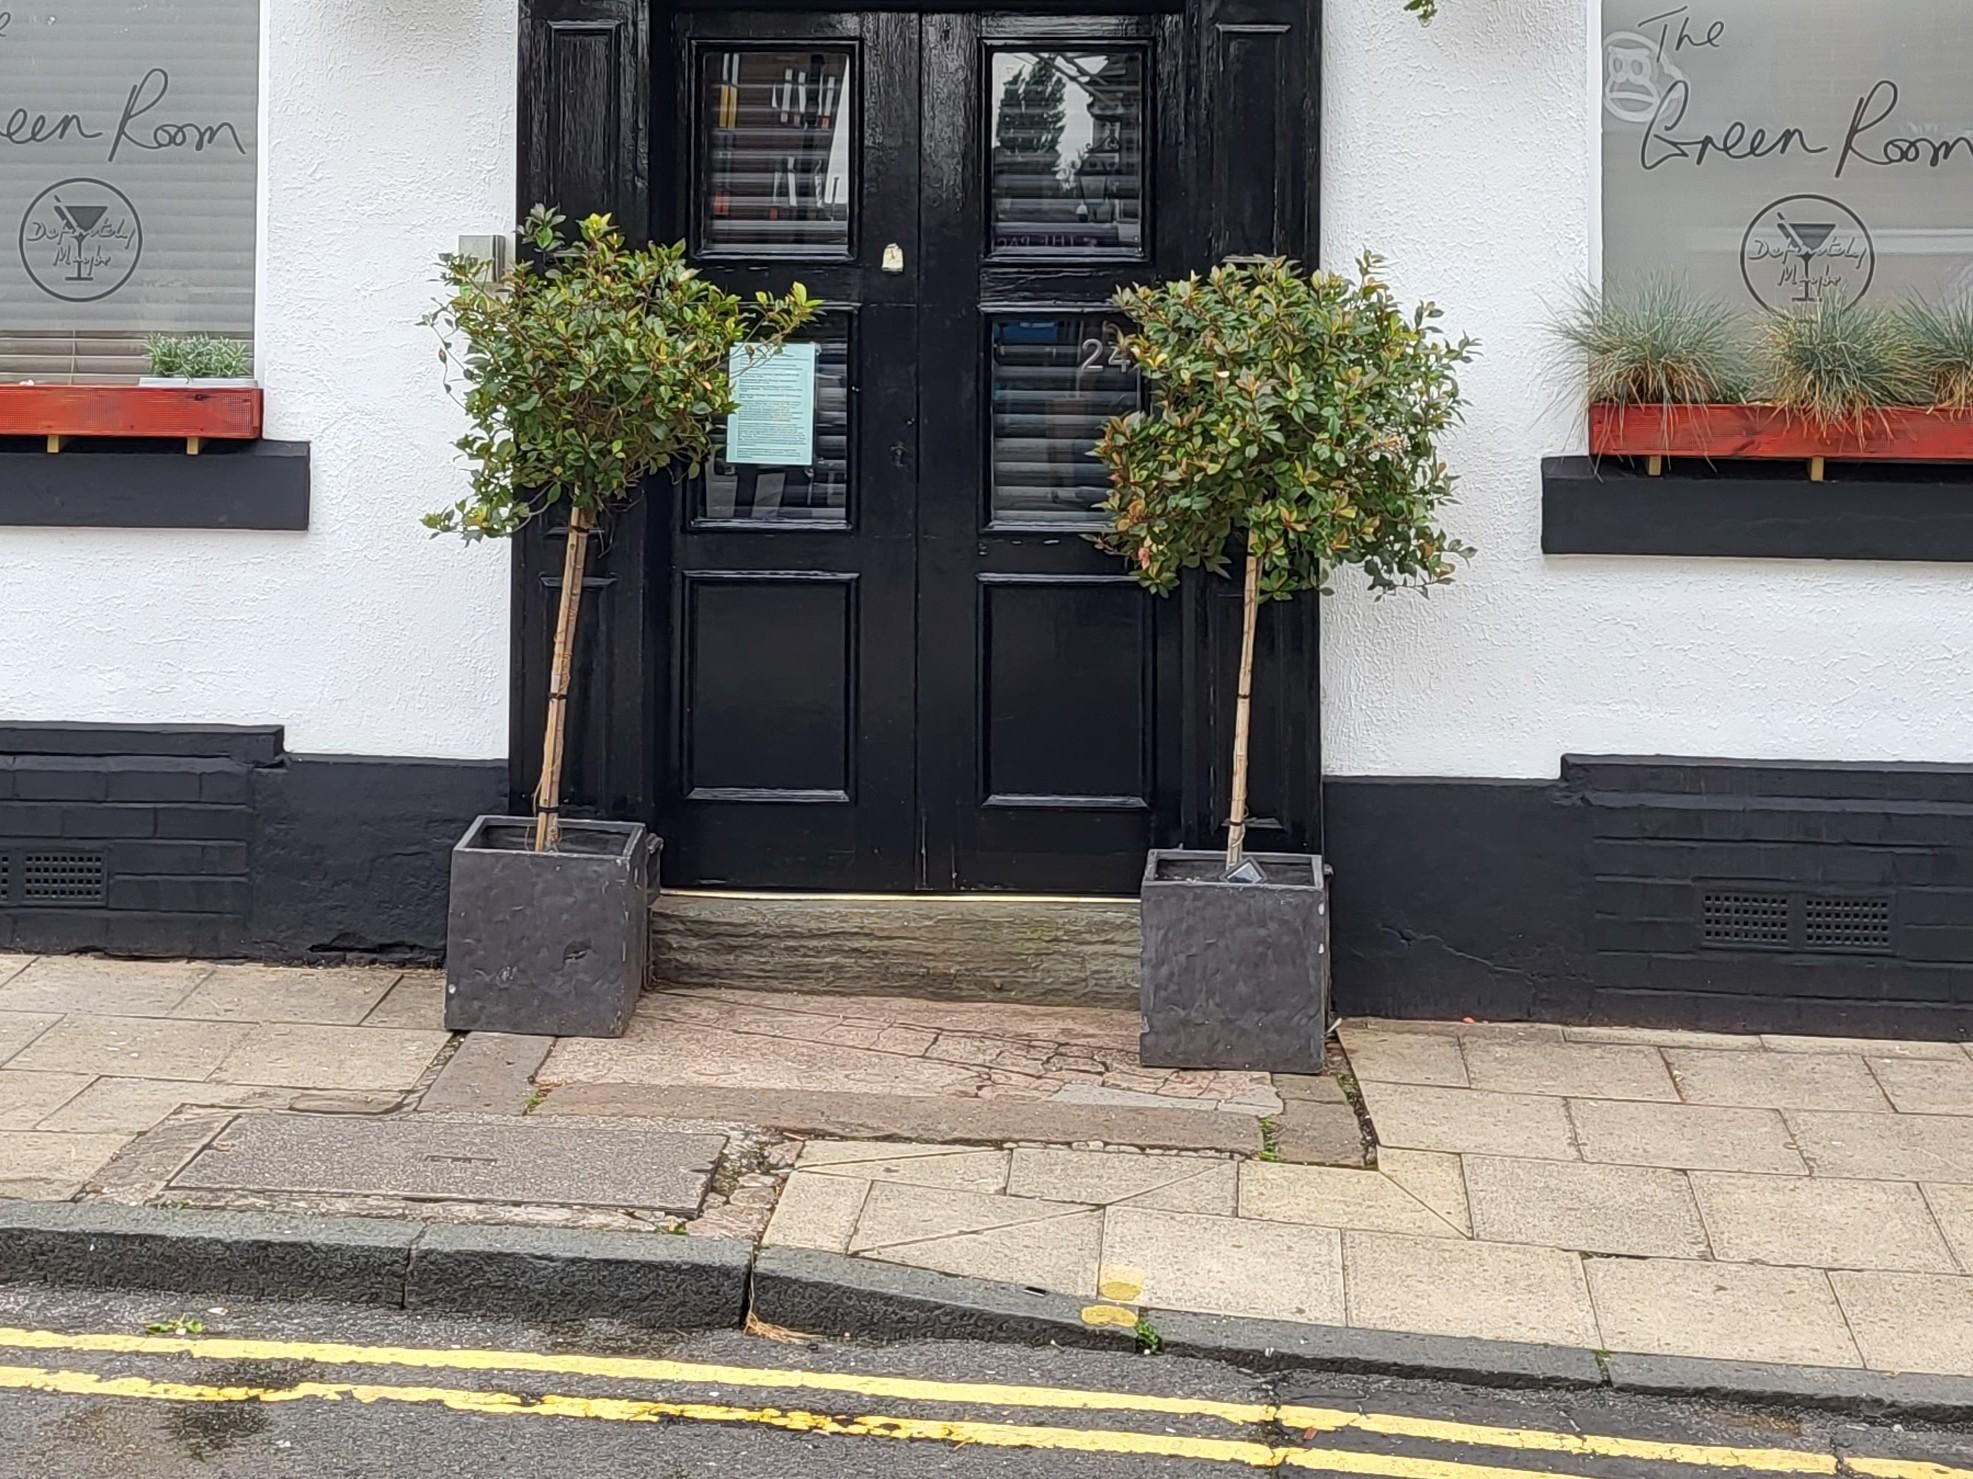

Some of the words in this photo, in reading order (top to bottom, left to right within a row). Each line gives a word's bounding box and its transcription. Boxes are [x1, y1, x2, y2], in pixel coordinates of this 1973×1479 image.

[1637, 5, 1724, 63] The
[0, 108, 103, 144] een
[107, 67, 246, 162] Room
[1641, 79, 1828, 170] Green
[1835, 80, 1973, 178] Room
